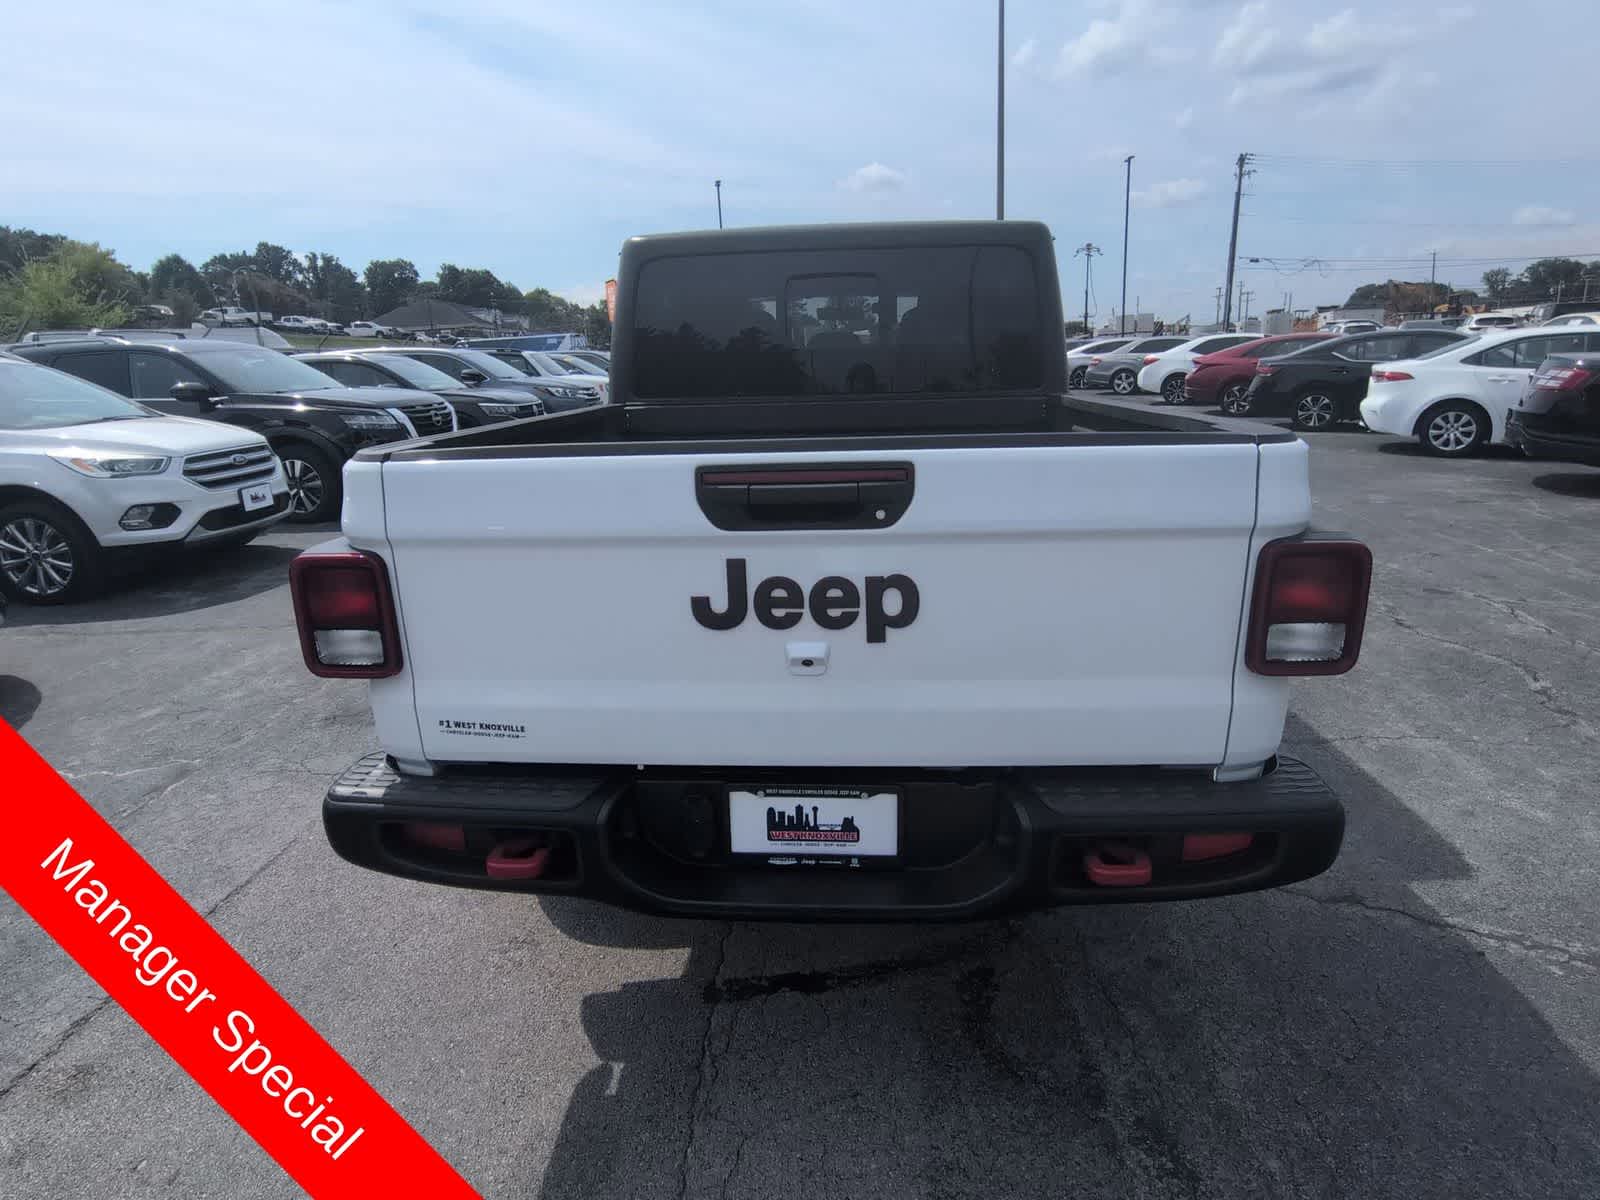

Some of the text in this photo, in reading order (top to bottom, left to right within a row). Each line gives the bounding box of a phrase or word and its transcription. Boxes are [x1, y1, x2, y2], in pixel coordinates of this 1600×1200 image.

[691, 559, 920, 643] Jeep
[453, 721, 476, 729] WEST
[479, 722, 526, 732] KNOXVILLE
